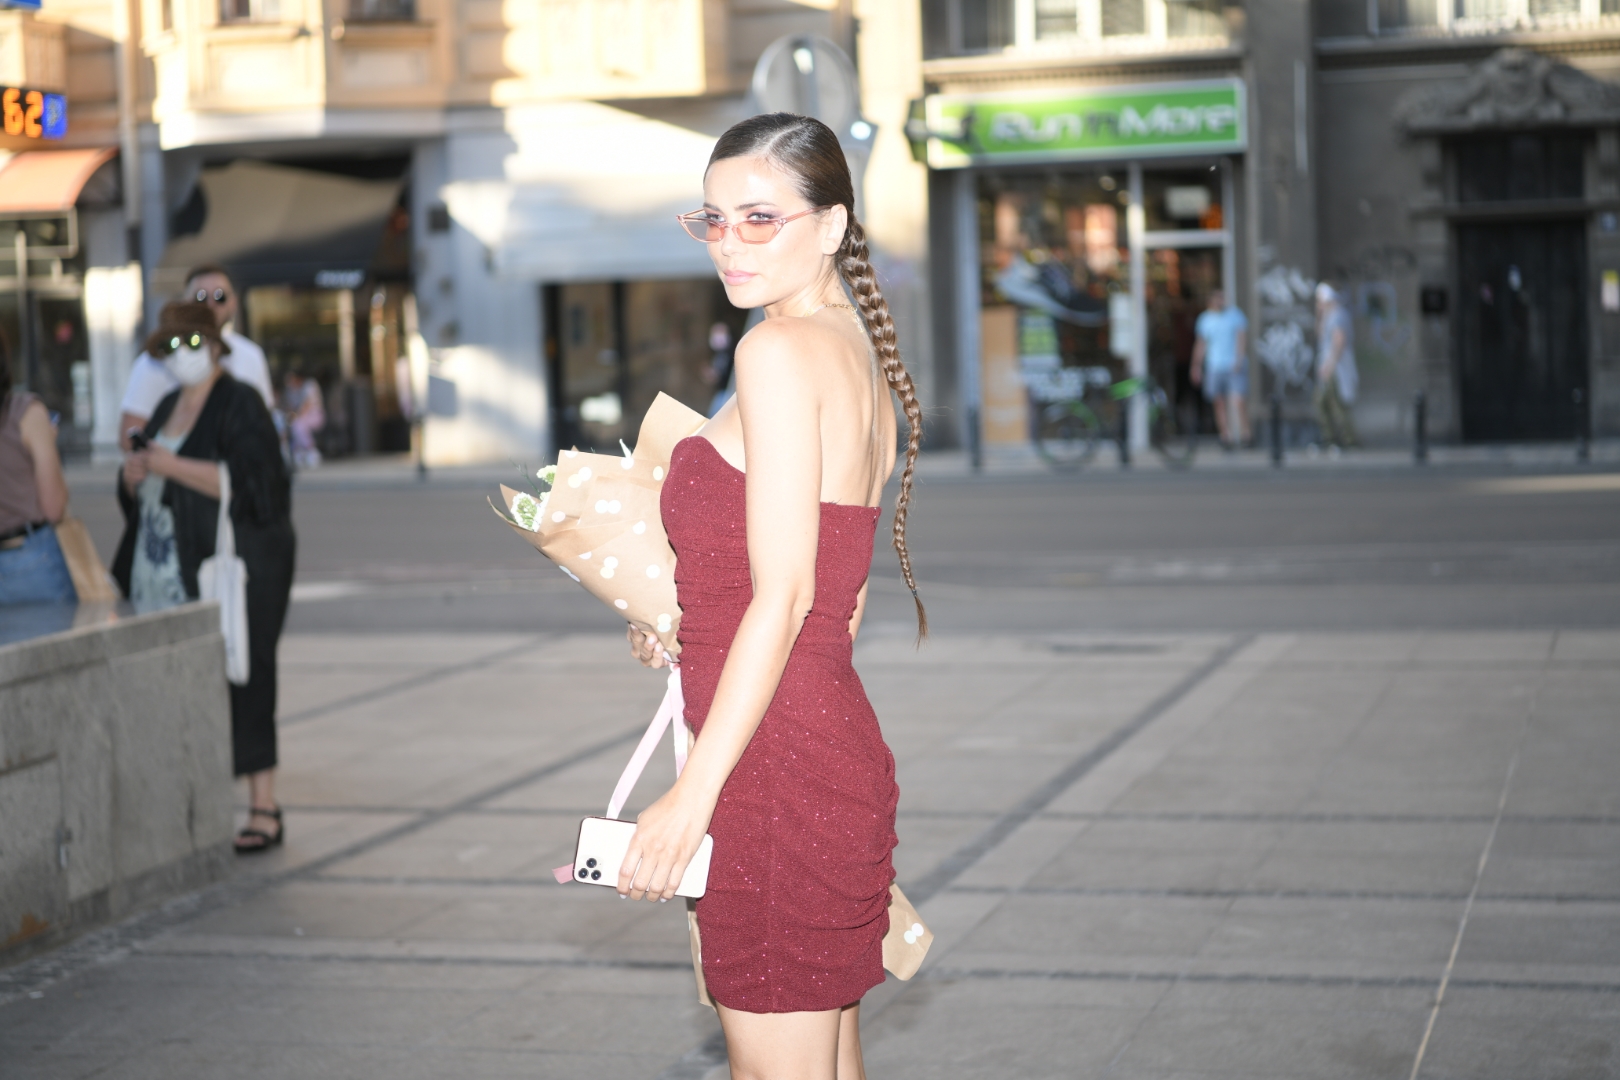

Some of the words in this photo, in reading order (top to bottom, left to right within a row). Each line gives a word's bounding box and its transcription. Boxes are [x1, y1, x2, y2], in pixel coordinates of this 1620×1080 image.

[3, 87, 43, 138] 62
[989, 111, 1083, 143] Run
[1119, 104, 1235, 138] More
